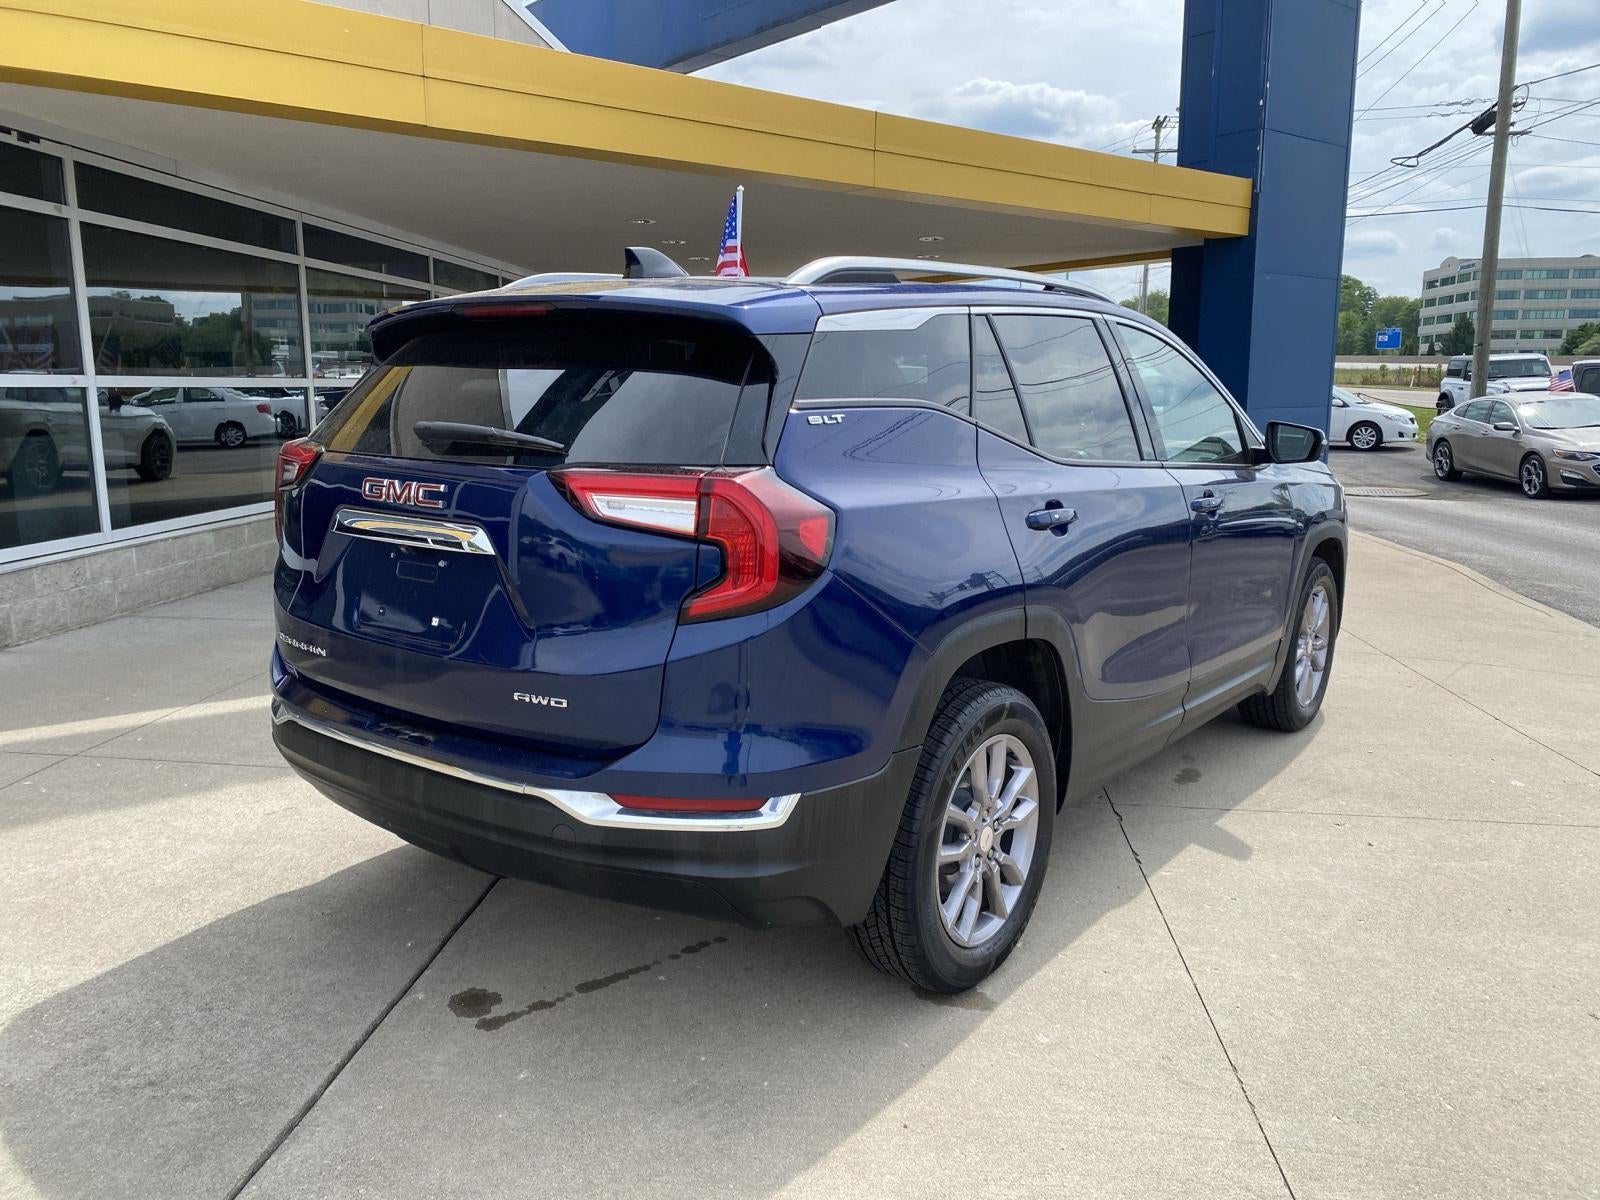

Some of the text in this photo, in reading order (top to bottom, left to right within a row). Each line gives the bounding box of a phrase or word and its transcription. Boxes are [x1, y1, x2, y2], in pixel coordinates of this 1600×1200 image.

[807, 413, 846, 425] SLT
[361, 477, 448, 508] GMC
[513, 692, 568, 708] AWD
